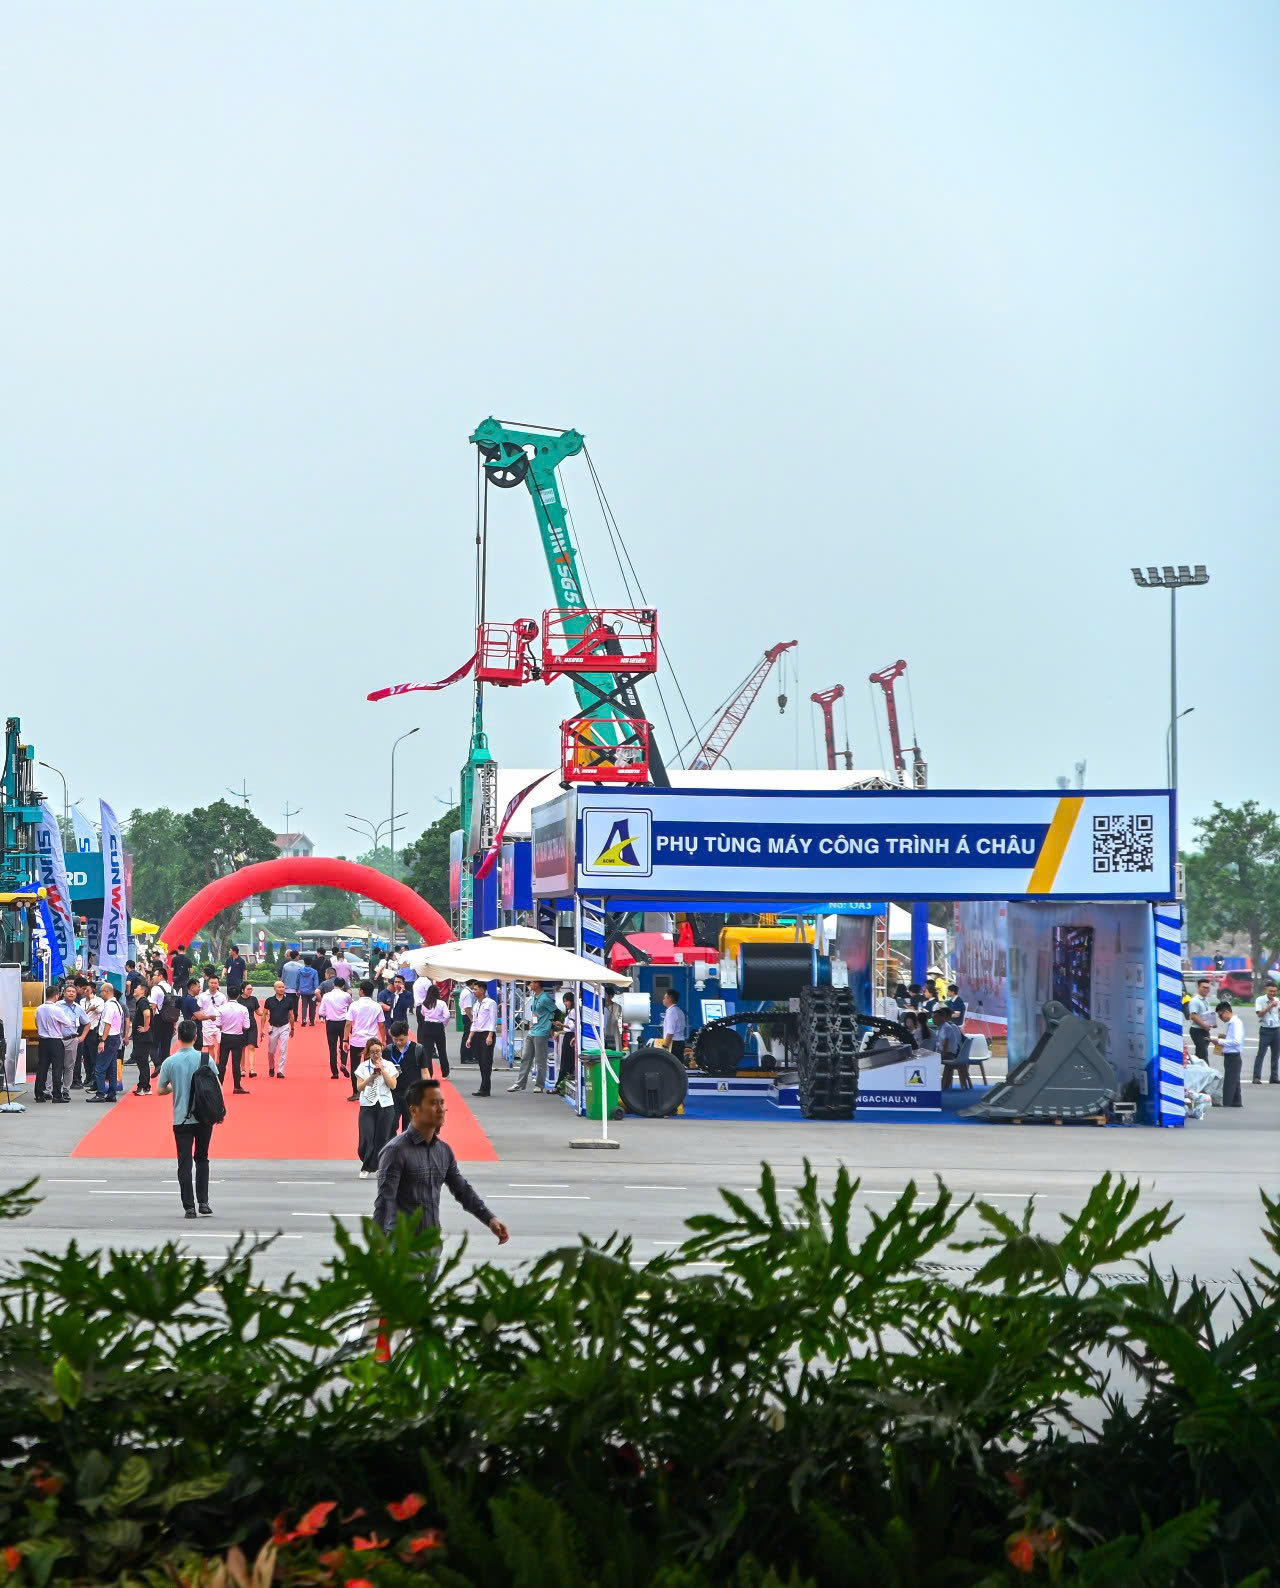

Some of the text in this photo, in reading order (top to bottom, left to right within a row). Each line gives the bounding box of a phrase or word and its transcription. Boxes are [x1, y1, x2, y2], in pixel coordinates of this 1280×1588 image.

[656, 833, 1035, 855] PHỤ TÙNG MÁY CÔNG TRÌNH Á CHÂU
[37, 830, 70, 961] SUNWARD
